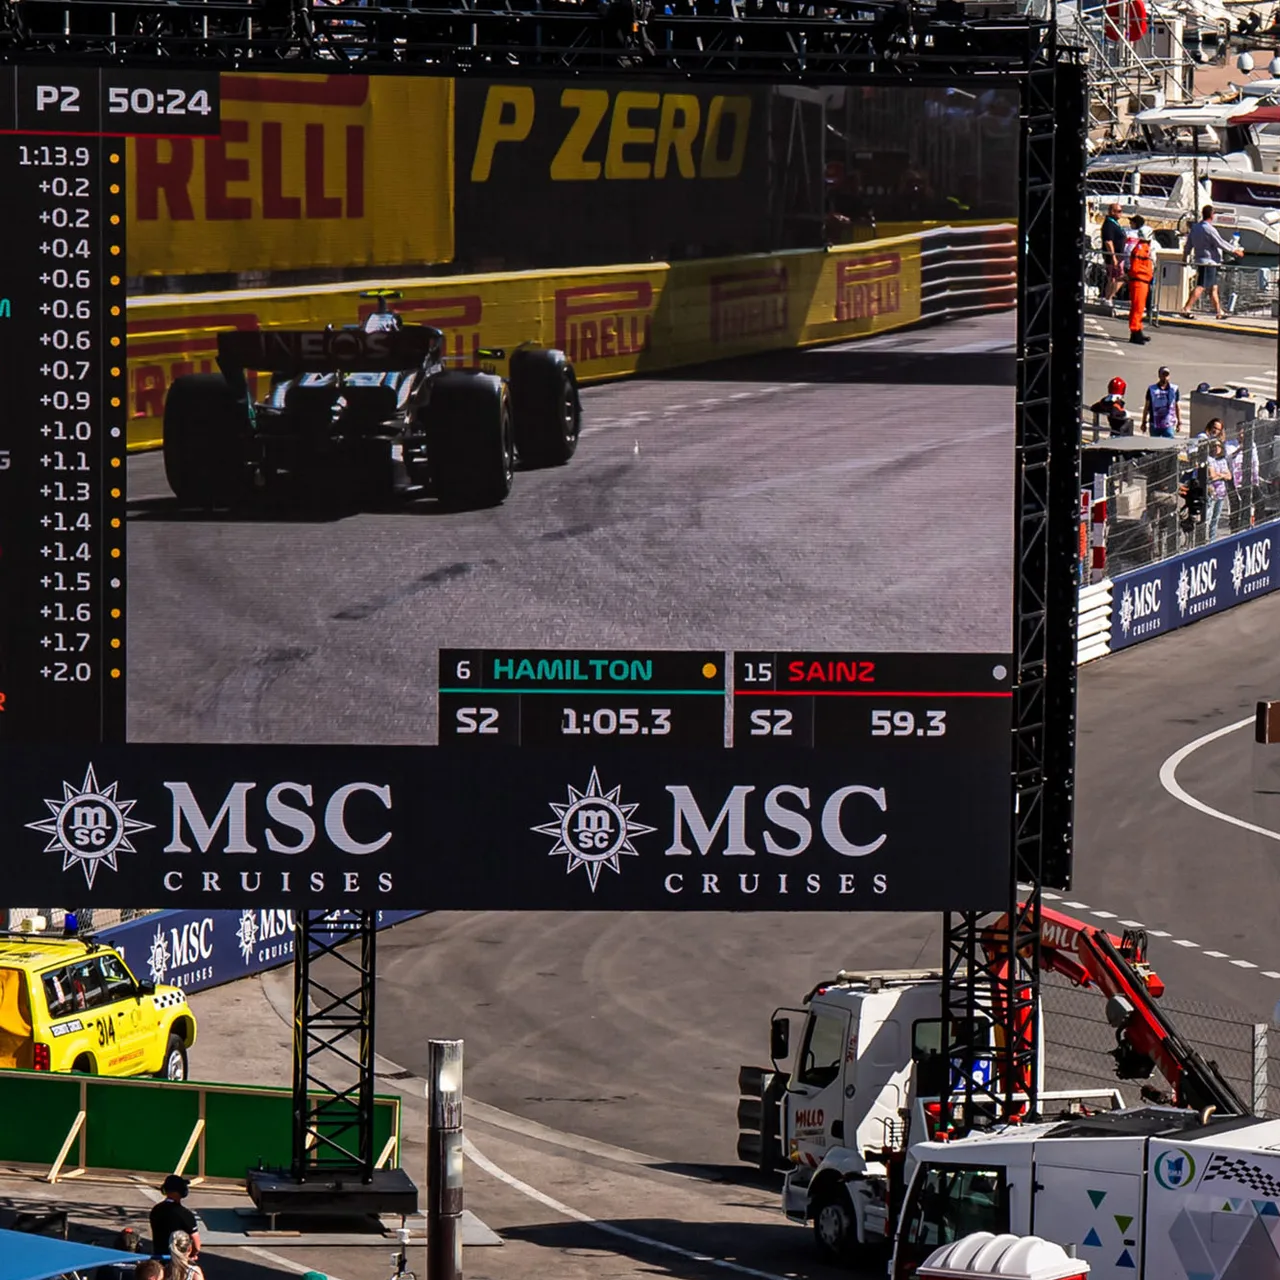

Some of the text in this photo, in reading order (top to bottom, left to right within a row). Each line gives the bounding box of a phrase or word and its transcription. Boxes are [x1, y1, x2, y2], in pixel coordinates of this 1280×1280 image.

[37, 86, 211, 115] P2 50:24
[473, 87, 751, 182] P ZERO
[20, 146, 89, 166] 1:13.9
[135, 120, 364, 221] RELLI
[39, 178, 89, 196] +0.2
[40, 208, 89, 227] +0.2
[40, 239, 90, 258] +0.4
[40, 270, 89, 288] +0.6
[836, 253, 901, 320] PIRELLI
[40, 300, 90, 318] +0.6
[555, 282, 653, 363] PIRELLI
[40, 330, 90, 349] +0.6
[40, 361, 89, 380] +0.7
[40, 391, 89, 410] +0.9
[41, 421, 91, 440] +1.0
[40, 452, 90, 470] +1.1
[40, 482, 89, 500] +1.3
[41, 512, 91, 531] +1.4
[41, 542, 91, 561] +1.4
[1245, 539, 1271, 575] MSC
[41, 572, 90, 590] +1.5
[1189, 559, 1217, 597] MSC
[1134, 579, 1161, 617] MSC
[41, 603, 90, 621] +1.6
[41, 633, 90, 651] +1.7
[40, 663, 91, 681] +2.0
[457, 659, 652, 680] 6 HAMILTON
[745, 661, 874, 682] 15 SAINZ
[457, 708, 670, 734] S2 1:05.3
[751, 710, 946, 736] S2 59.3
[164, 782, 392, 854] MSC
[665, 785, 887, 856] MSC
[164, 872, 392, 892] CRUISES
[665, 874, 886, 893] CRUISES
[171, 918, 213, 968] MSC
[1042, 922, 1079, 950] MILL
[259, 941, 293, 962] CRUISE
[97, 1014, 115, 1046] 314
